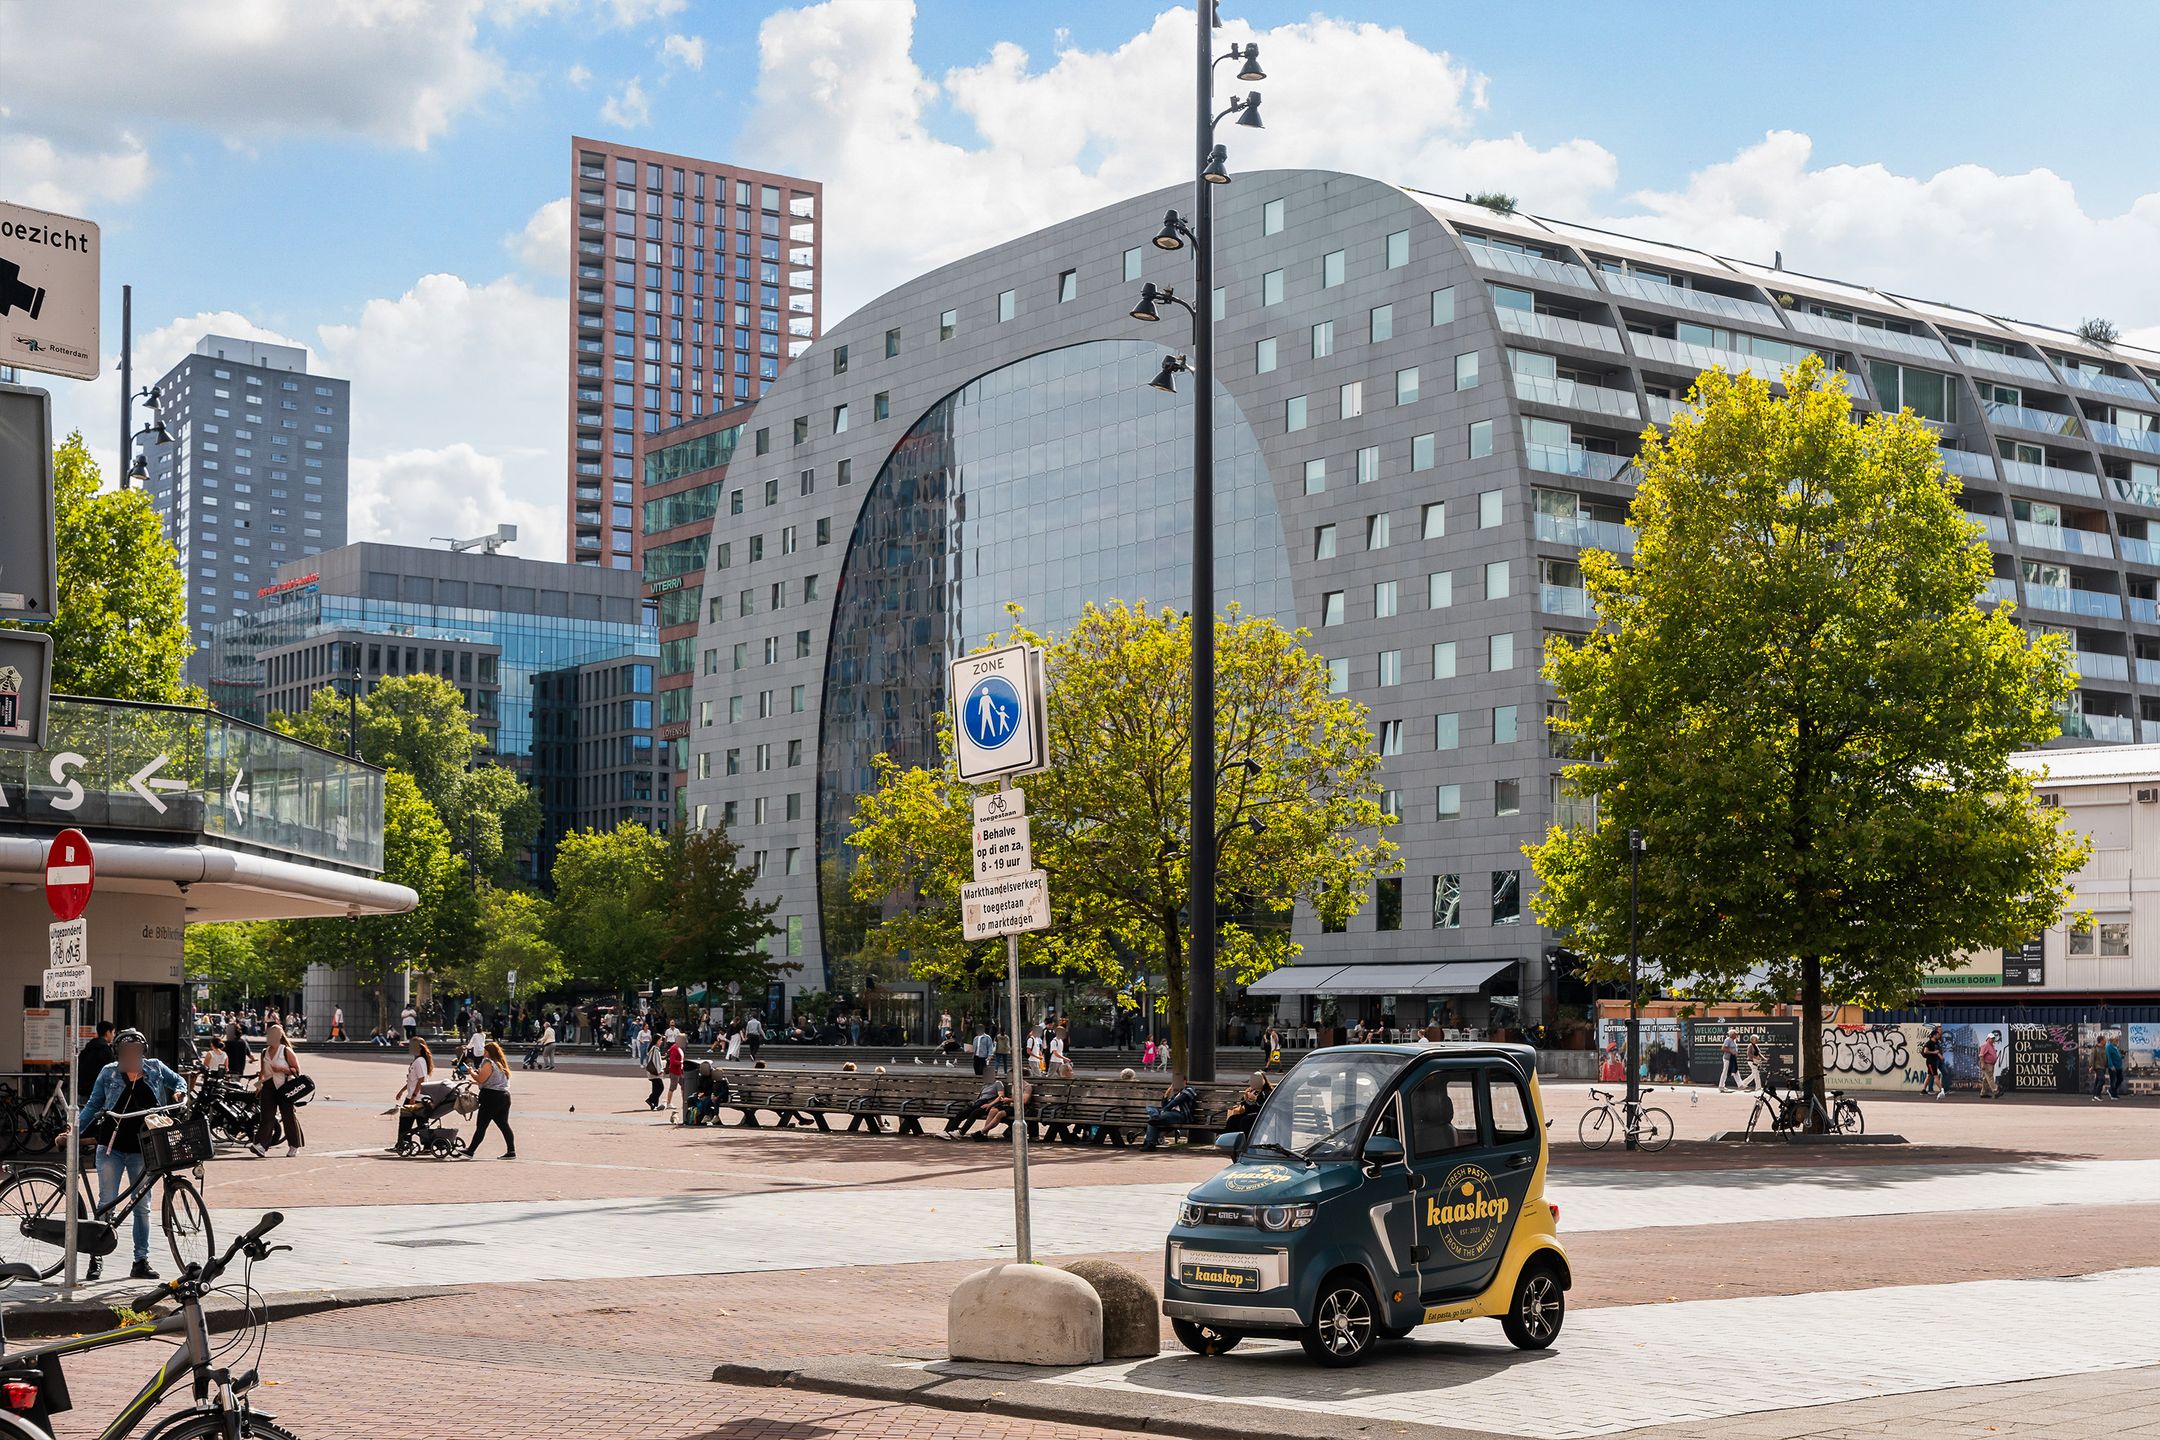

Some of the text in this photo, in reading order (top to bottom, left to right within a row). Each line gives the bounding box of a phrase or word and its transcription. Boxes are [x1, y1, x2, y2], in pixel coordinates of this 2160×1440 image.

[1, 221, 88, 253] oezicht
[49, 344, 89, 360] Rotterdam
[651, 577, 684, 593] VITERRA
[973, 657, 1005, 675] ZONE
[980, 810, 1017, 823] toegestaan
[983, 826, 1016, 841] Behalve
[977, 841, 1024, 859] op di en za,
[981, 861, 987, 872] 8
[994, 858, 1005, 870] 19
[1007, 857, 1021, 868] uur
[964, 878, 1042, 900] Markthandelsverkeer
[983, 899, 1024, 914] toegestaan
[142, 924, 153, 939] de
[977, 915, 1033, 933] op marktdagen
[1968, 976, 1996, 984] BODEM
[2016, 1030, 2048, 1041] THUIS
[2015, 1053, 2059, 1064] ROTTER
[2016, 1064, 2054, 1075] DAMSE
[2016, 1076, 2057, 1087] BODEM
[1447, 1167, 1489, 1187] FRESH PASTA
[1427, 1190, 1509, 1227] kaaskop
[1444, 1228, 1496, 1257] FROM THE WHEEL
[1195, 1266, 1243, 1288] kaaskop
